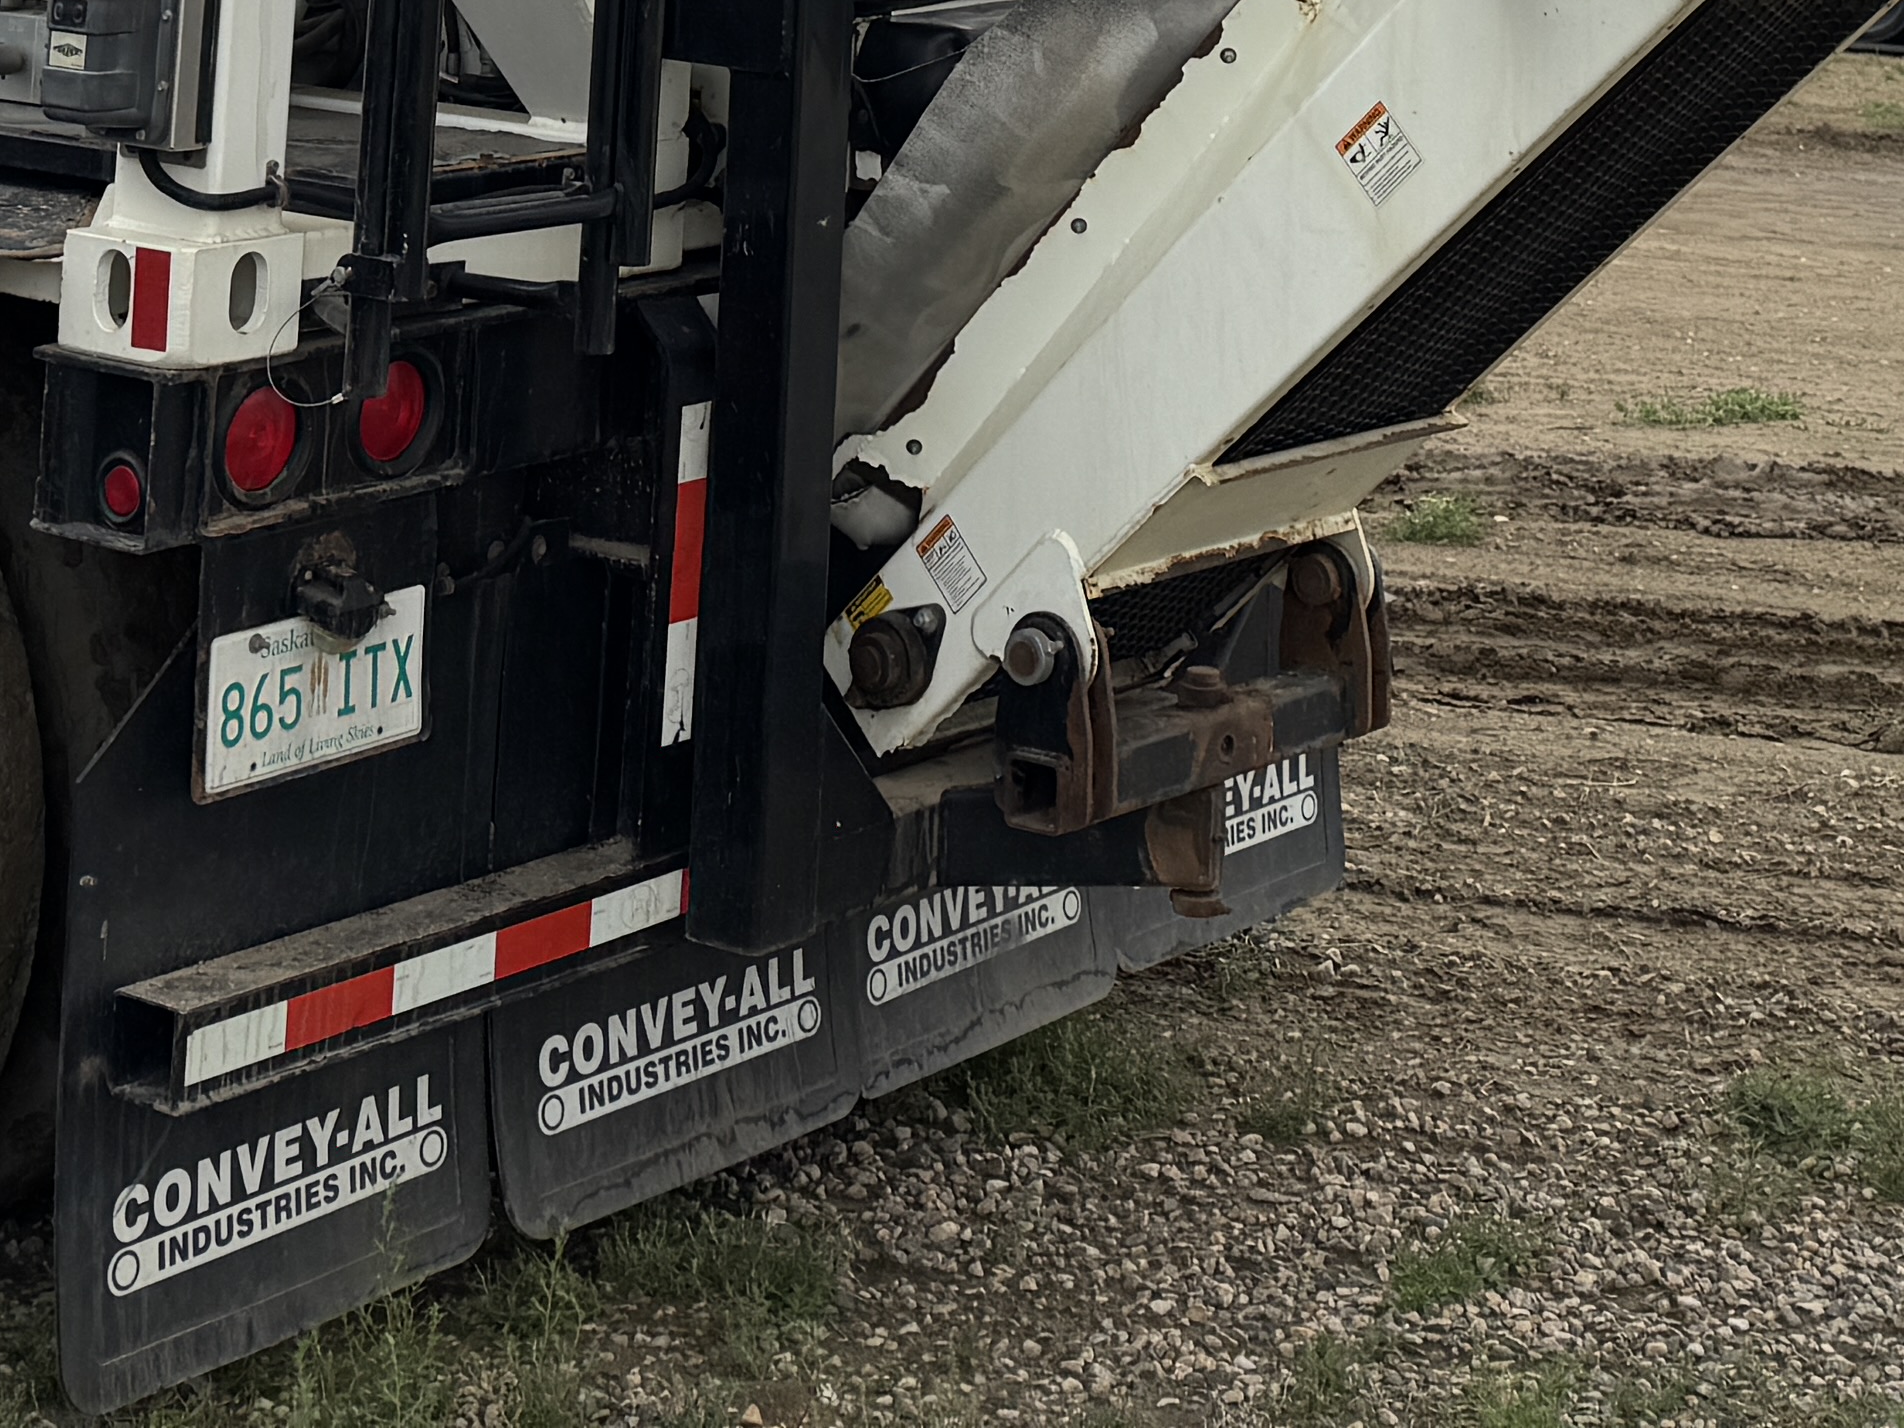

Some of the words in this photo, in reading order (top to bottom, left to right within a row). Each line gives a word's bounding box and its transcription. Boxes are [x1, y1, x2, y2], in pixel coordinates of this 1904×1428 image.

[221, 664, 303, 748] 865
[337, 634, 414, 717] ITX
[262, 745, 291, 768] Land
[294, 740, 306, 761] of
[309, 734, 344, 756] Living
[347, 724, 374, 744] Skies
[1224, 753, 1314, 817] EY-ALL
[1262, 805, 1293, 834] INC.
[897, 920, 1011, 987] INDUSTRIES
[1018, 904, 1054, 935] INC.
[539, 948, 815, 1087] CONVEY-ALL
[579, 1034, 730, 1114] INDUSTRIES
[738, 1015, 787, 1054] INC.
[112, 1074, 442, 1243] CONVEY-ALL
[158, 1173, 339, 1271] INDUSTRIES
[349, 1149, 406, 1194] INC.
